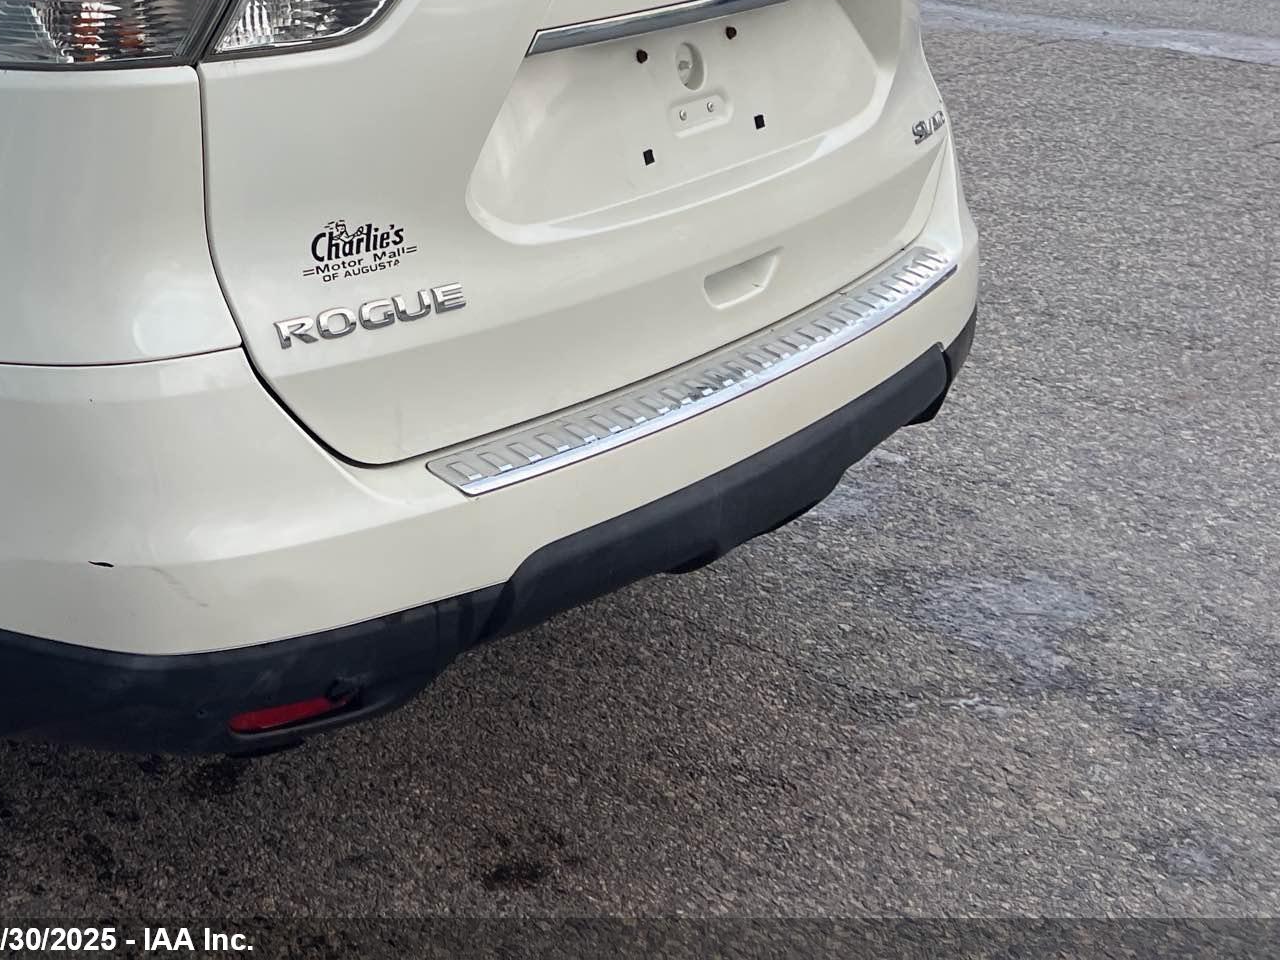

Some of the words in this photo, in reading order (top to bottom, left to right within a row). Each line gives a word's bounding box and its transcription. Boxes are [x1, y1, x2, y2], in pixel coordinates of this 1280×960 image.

[311, 223, 404, 262] Charlie's
[315, 258, 364, 275] Motor
[373, 246, 405, 262] Mall
[322, 272, 339, 283] OF
[344, 258, 400, 279] AUGUSTA
[273, 282, 467, 350] ROGUE
